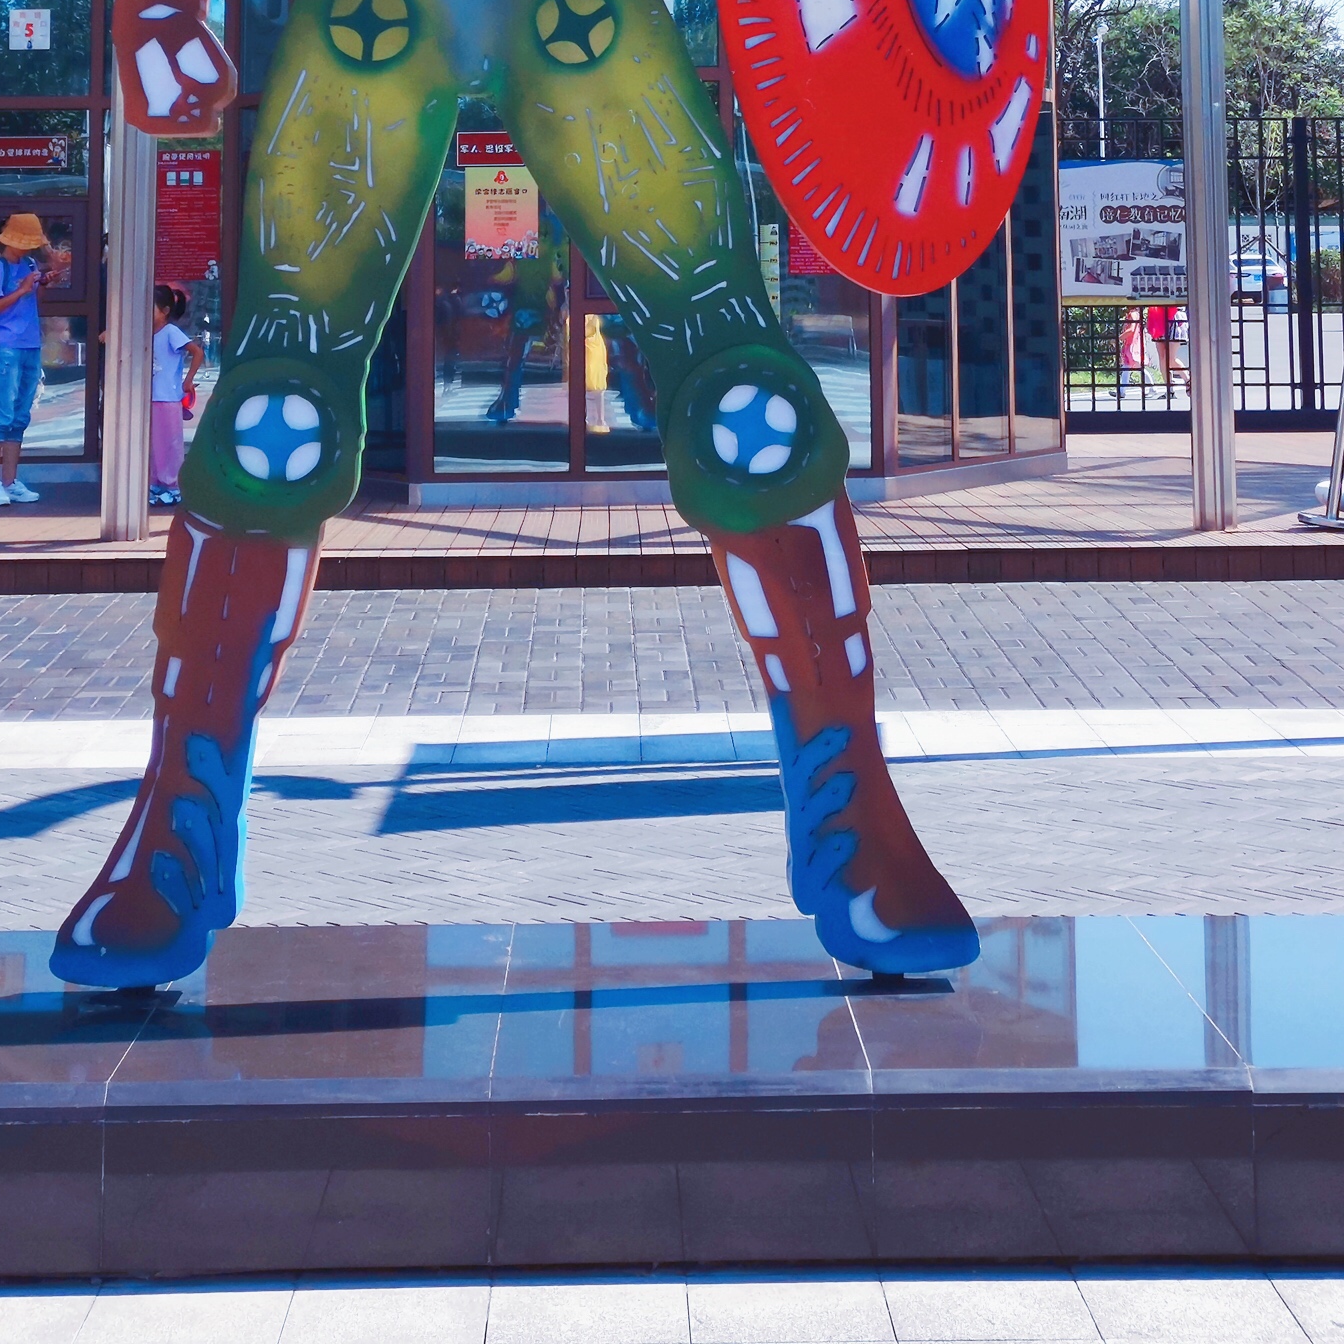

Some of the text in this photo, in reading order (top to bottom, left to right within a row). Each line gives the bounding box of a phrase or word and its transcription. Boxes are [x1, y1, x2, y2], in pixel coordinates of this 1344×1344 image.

[25, 23, 34, 37] 5
[460, 143, 518, 153] 军人、退役军
[1102, 207, 1185, 222] 培仁教育记忆
